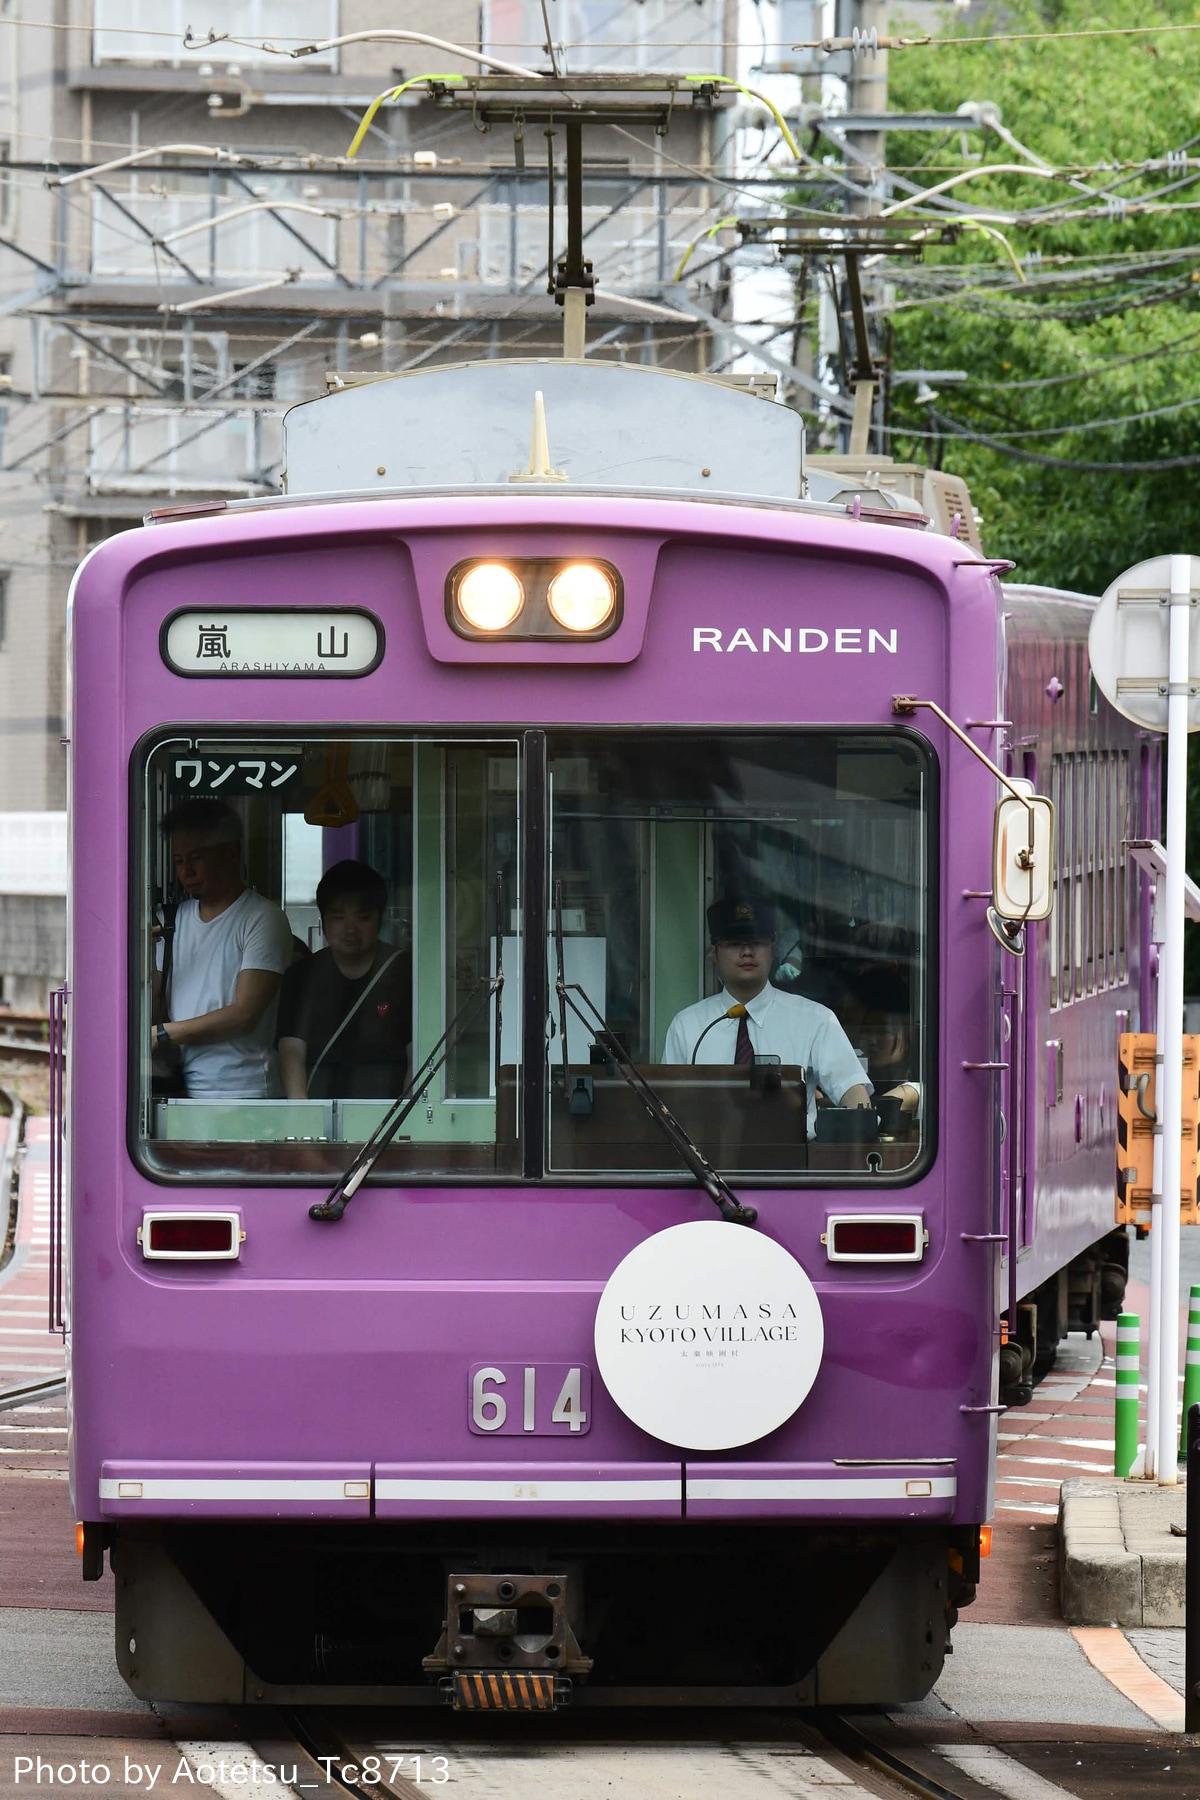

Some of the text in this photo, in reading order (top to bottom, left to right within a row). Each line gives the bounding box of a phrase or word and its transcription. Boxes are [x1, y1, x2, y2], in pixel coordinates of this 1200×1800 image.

[196, 624, 348, 659] 嵐山
[693, 627, 898, 654] RANDEN
[219, 661, 326, 671] ARASHIYAMA
[175, 760, 298, 789] ワンマン
[620, 1303, 798, 1321] UZUMASA
[620, 1326, 798, 1344] KYOTO VILLAGE
[472, 1367, 587, 1431] 614
